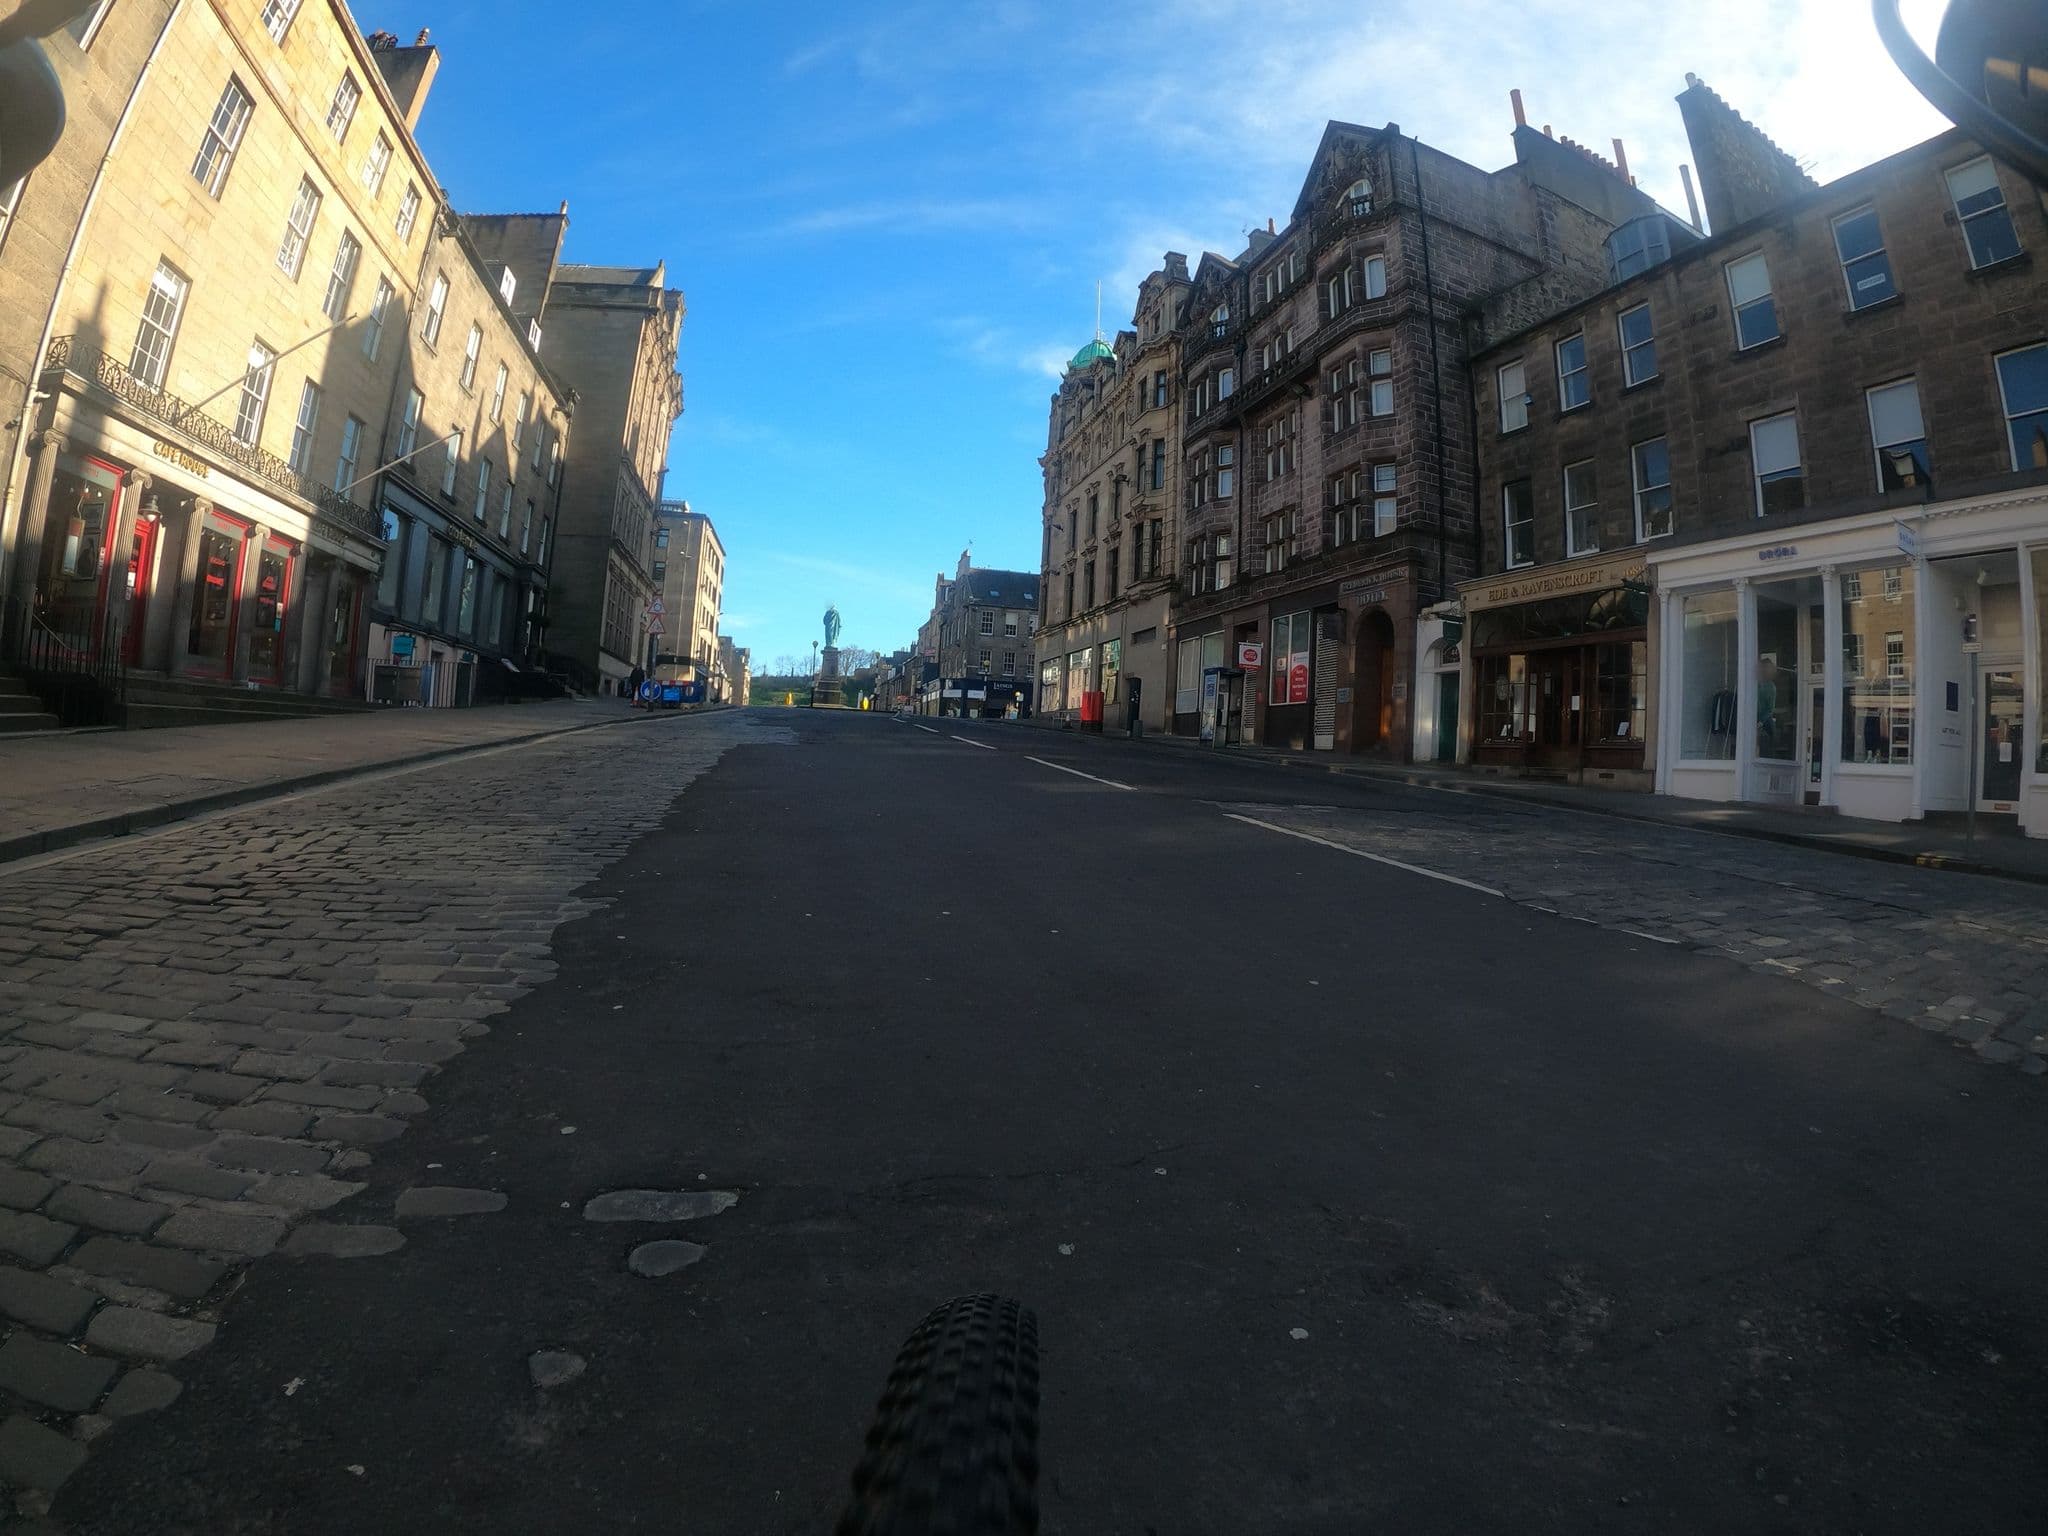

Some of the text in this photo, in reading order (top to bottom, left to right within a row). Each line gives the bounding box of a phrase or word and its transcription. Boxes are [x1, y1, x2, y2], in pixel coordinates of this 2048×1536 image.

[179, 453, 209, 479] ROUGE
[1488, 588, 1509, 602] EDE
[1510, 587, 1519, 598] &
[1521, 569, 1604, 597] RAVENSCROFT
